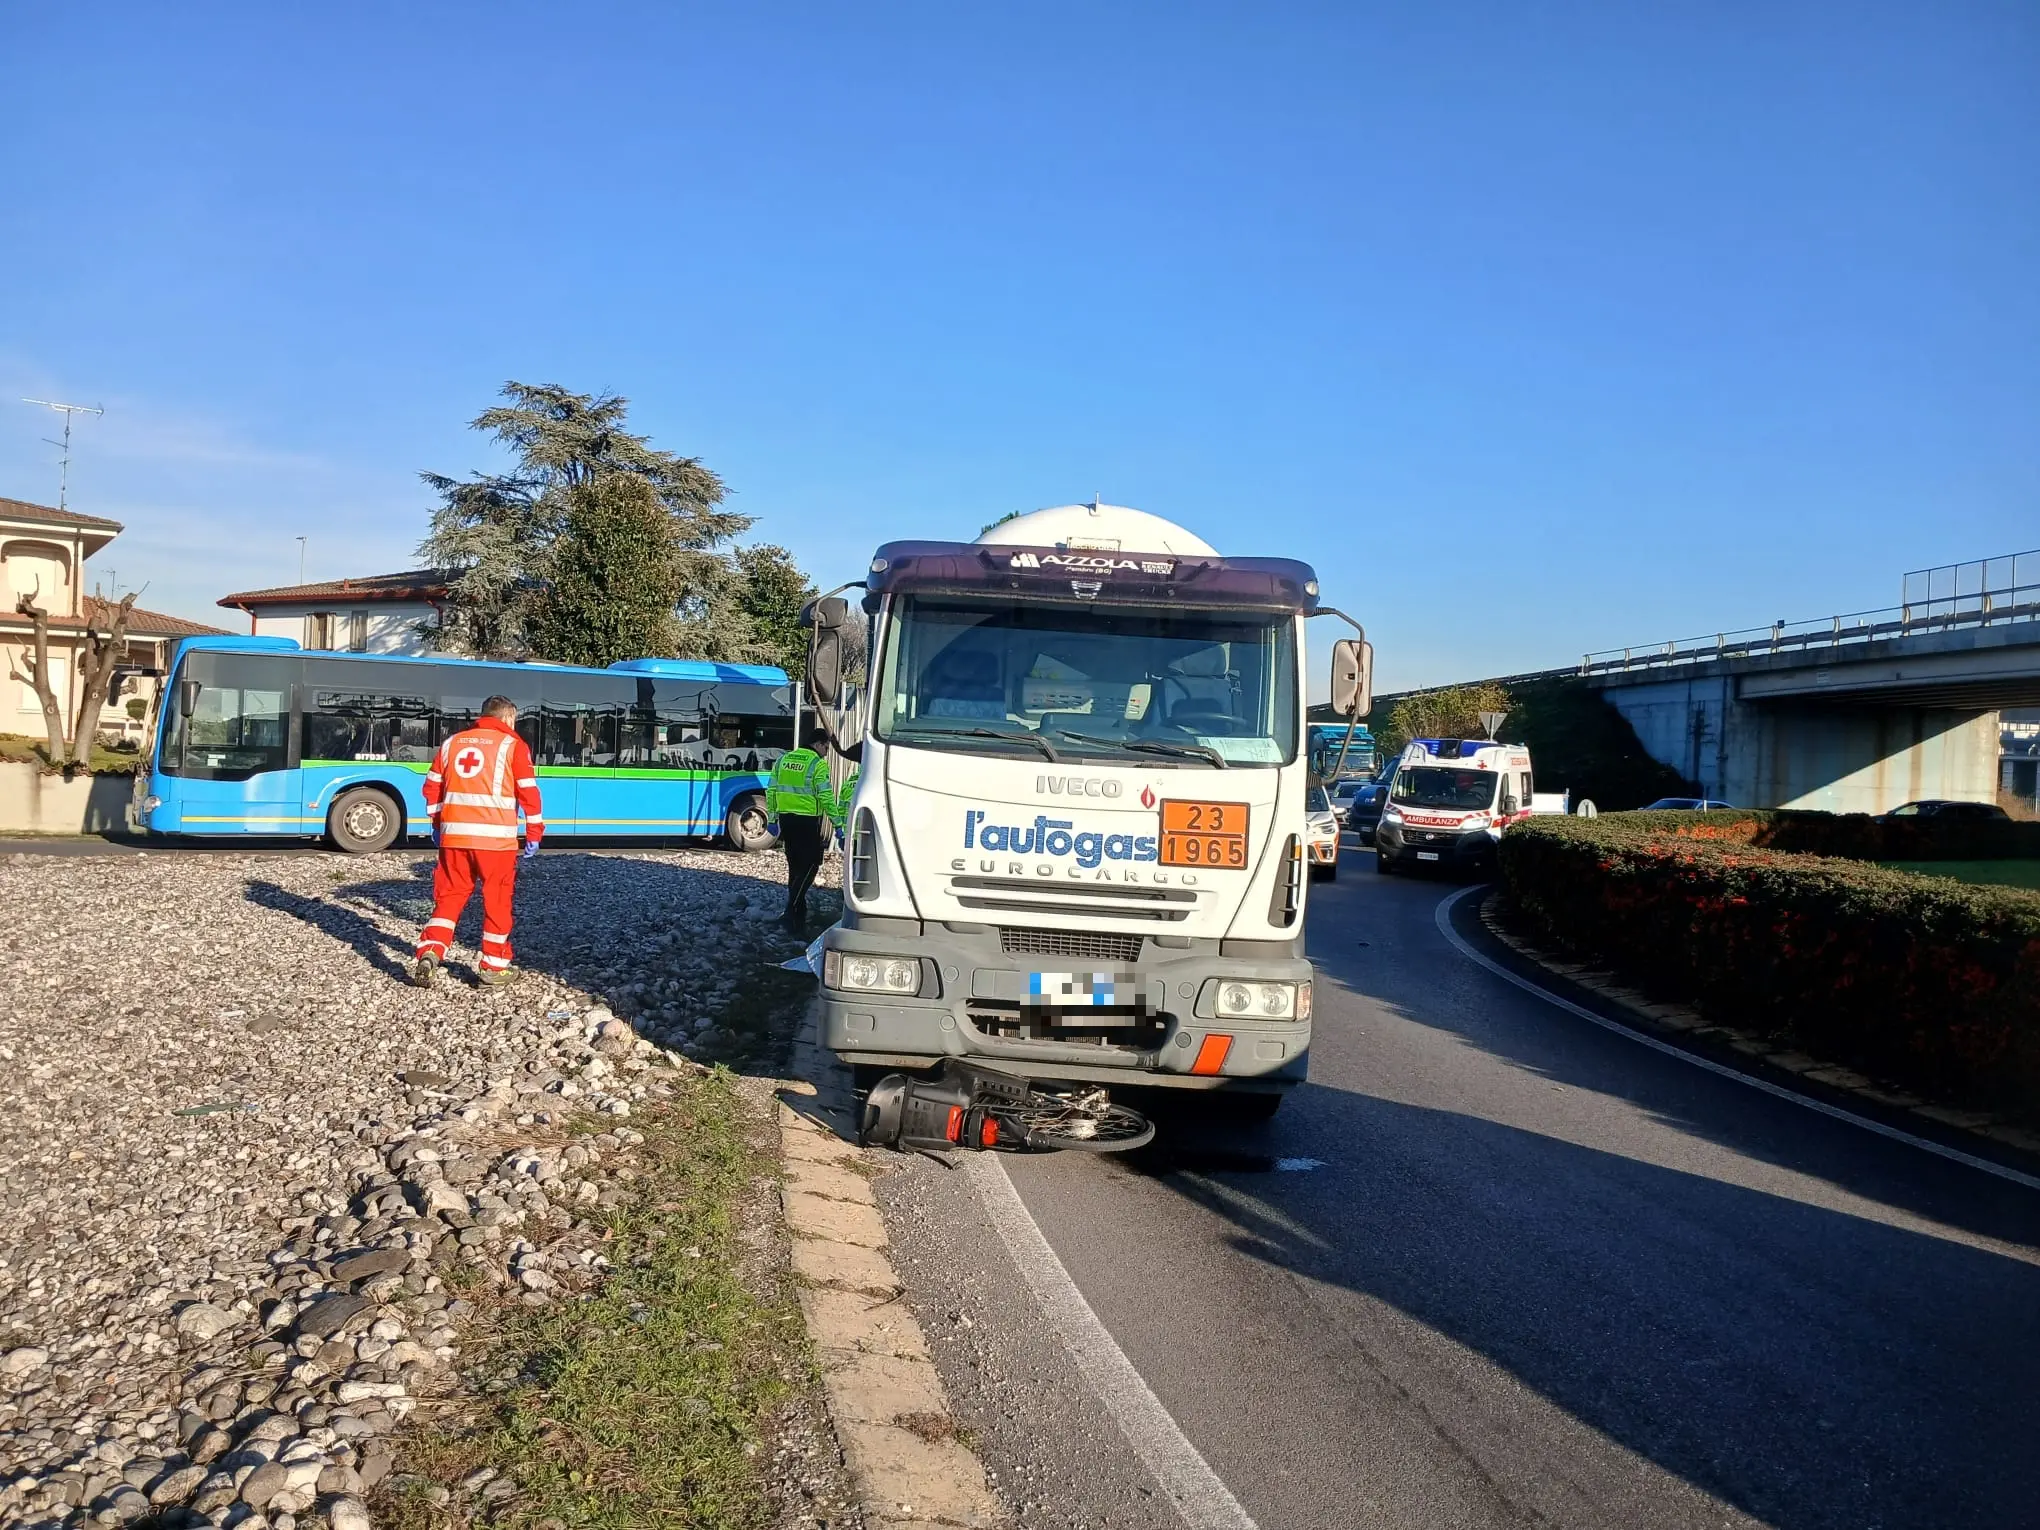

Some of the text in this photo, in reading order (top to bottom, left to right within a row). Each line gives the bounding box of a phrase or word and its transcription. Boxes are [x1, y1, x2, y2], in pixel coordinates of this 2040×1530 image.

[1040, 554, 1140, 570] AZZOLA
[1035, 775, 1122, 798] IVECO
[1186, 805, 1224, 831] 23
[1406, 815, 1458, 826] AMBULANZA
[1167, 837, 1243, 865] 1965
[951, 858, 1197, 885] EUROCARGO
